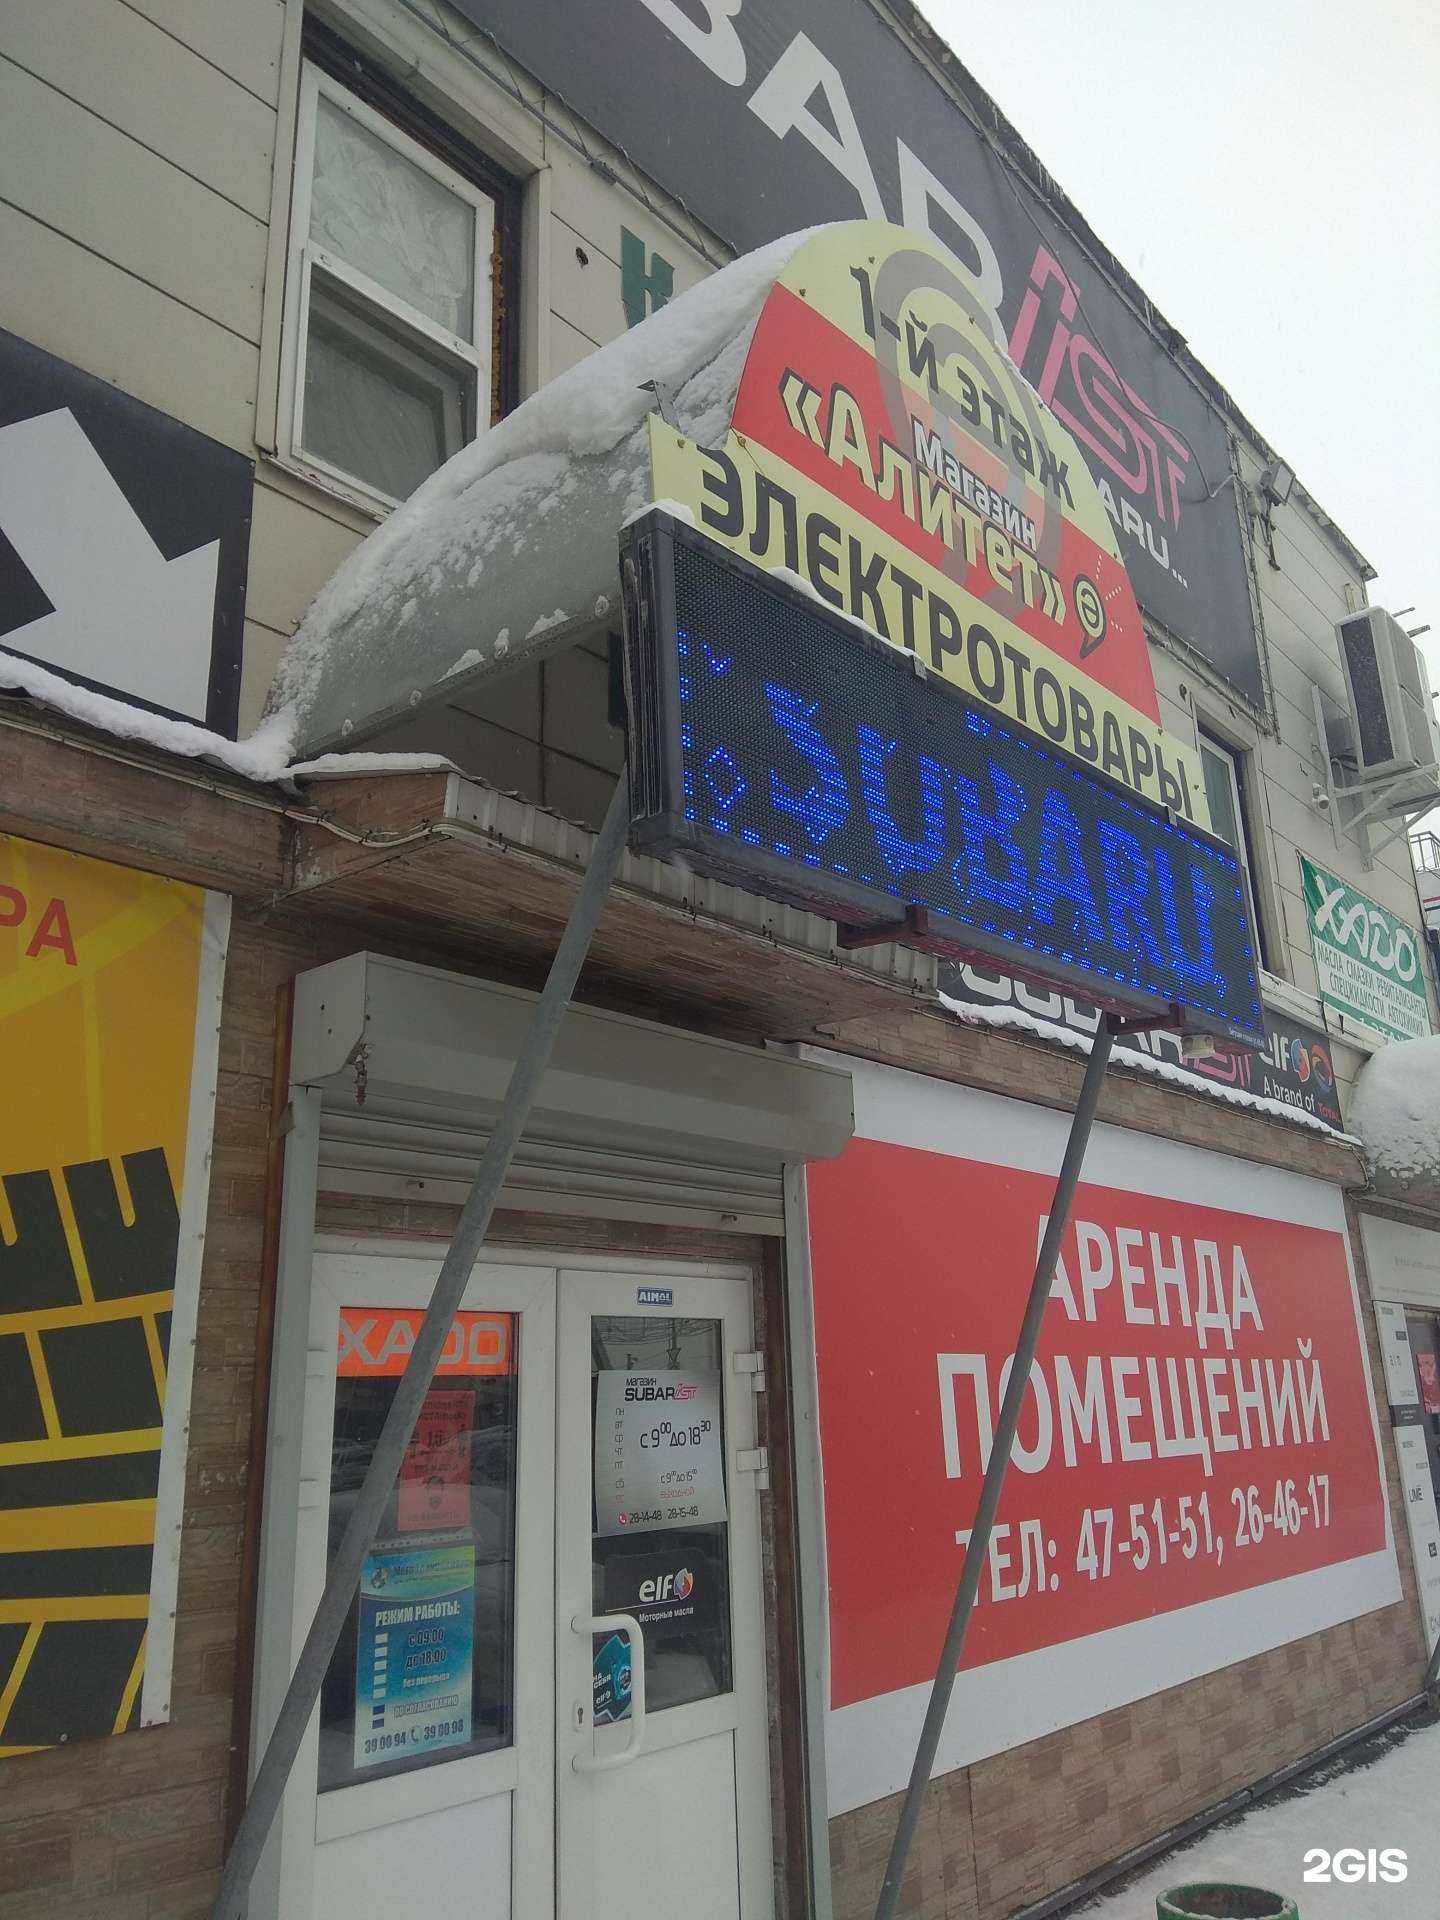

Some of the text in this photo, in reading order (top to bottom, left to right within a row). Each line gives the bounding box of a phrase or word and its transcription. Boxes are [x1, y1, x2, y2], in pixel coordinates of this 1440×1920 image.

[779, 367, 1067, 628] «Алитет»
[911, 413, 1038, 554] Магазин
[699, 443, 1194, 819] ЭЛЕКТРОТОВАРЫ
[763, 680, 1228, 1000] SUBARU
[1315, 874, 1417, 982] XADO
[1317, 940, 1344, 976] МАСЛА
[1346, 958, 1375, 992] СМАЗКИ
[1263, 1074, 1272, 1096] A
[1273, 1079, 1304, 1109] brand
[1305, 1092, 1316, 1113] of
[937, 1337, 1330, 1478] ПОМЕЩЕНИЙ
[1076, 1493, 1225, 1582] 47-51-51,
[1231, 1475, 1331, 1547] 26-46-17
[376, 1600, 461, 1627] РЕЖИМ РАБОТЫ:
[639, 1573, 674, 1602] elf
[639, 1609, 673, 1623] Моторные
